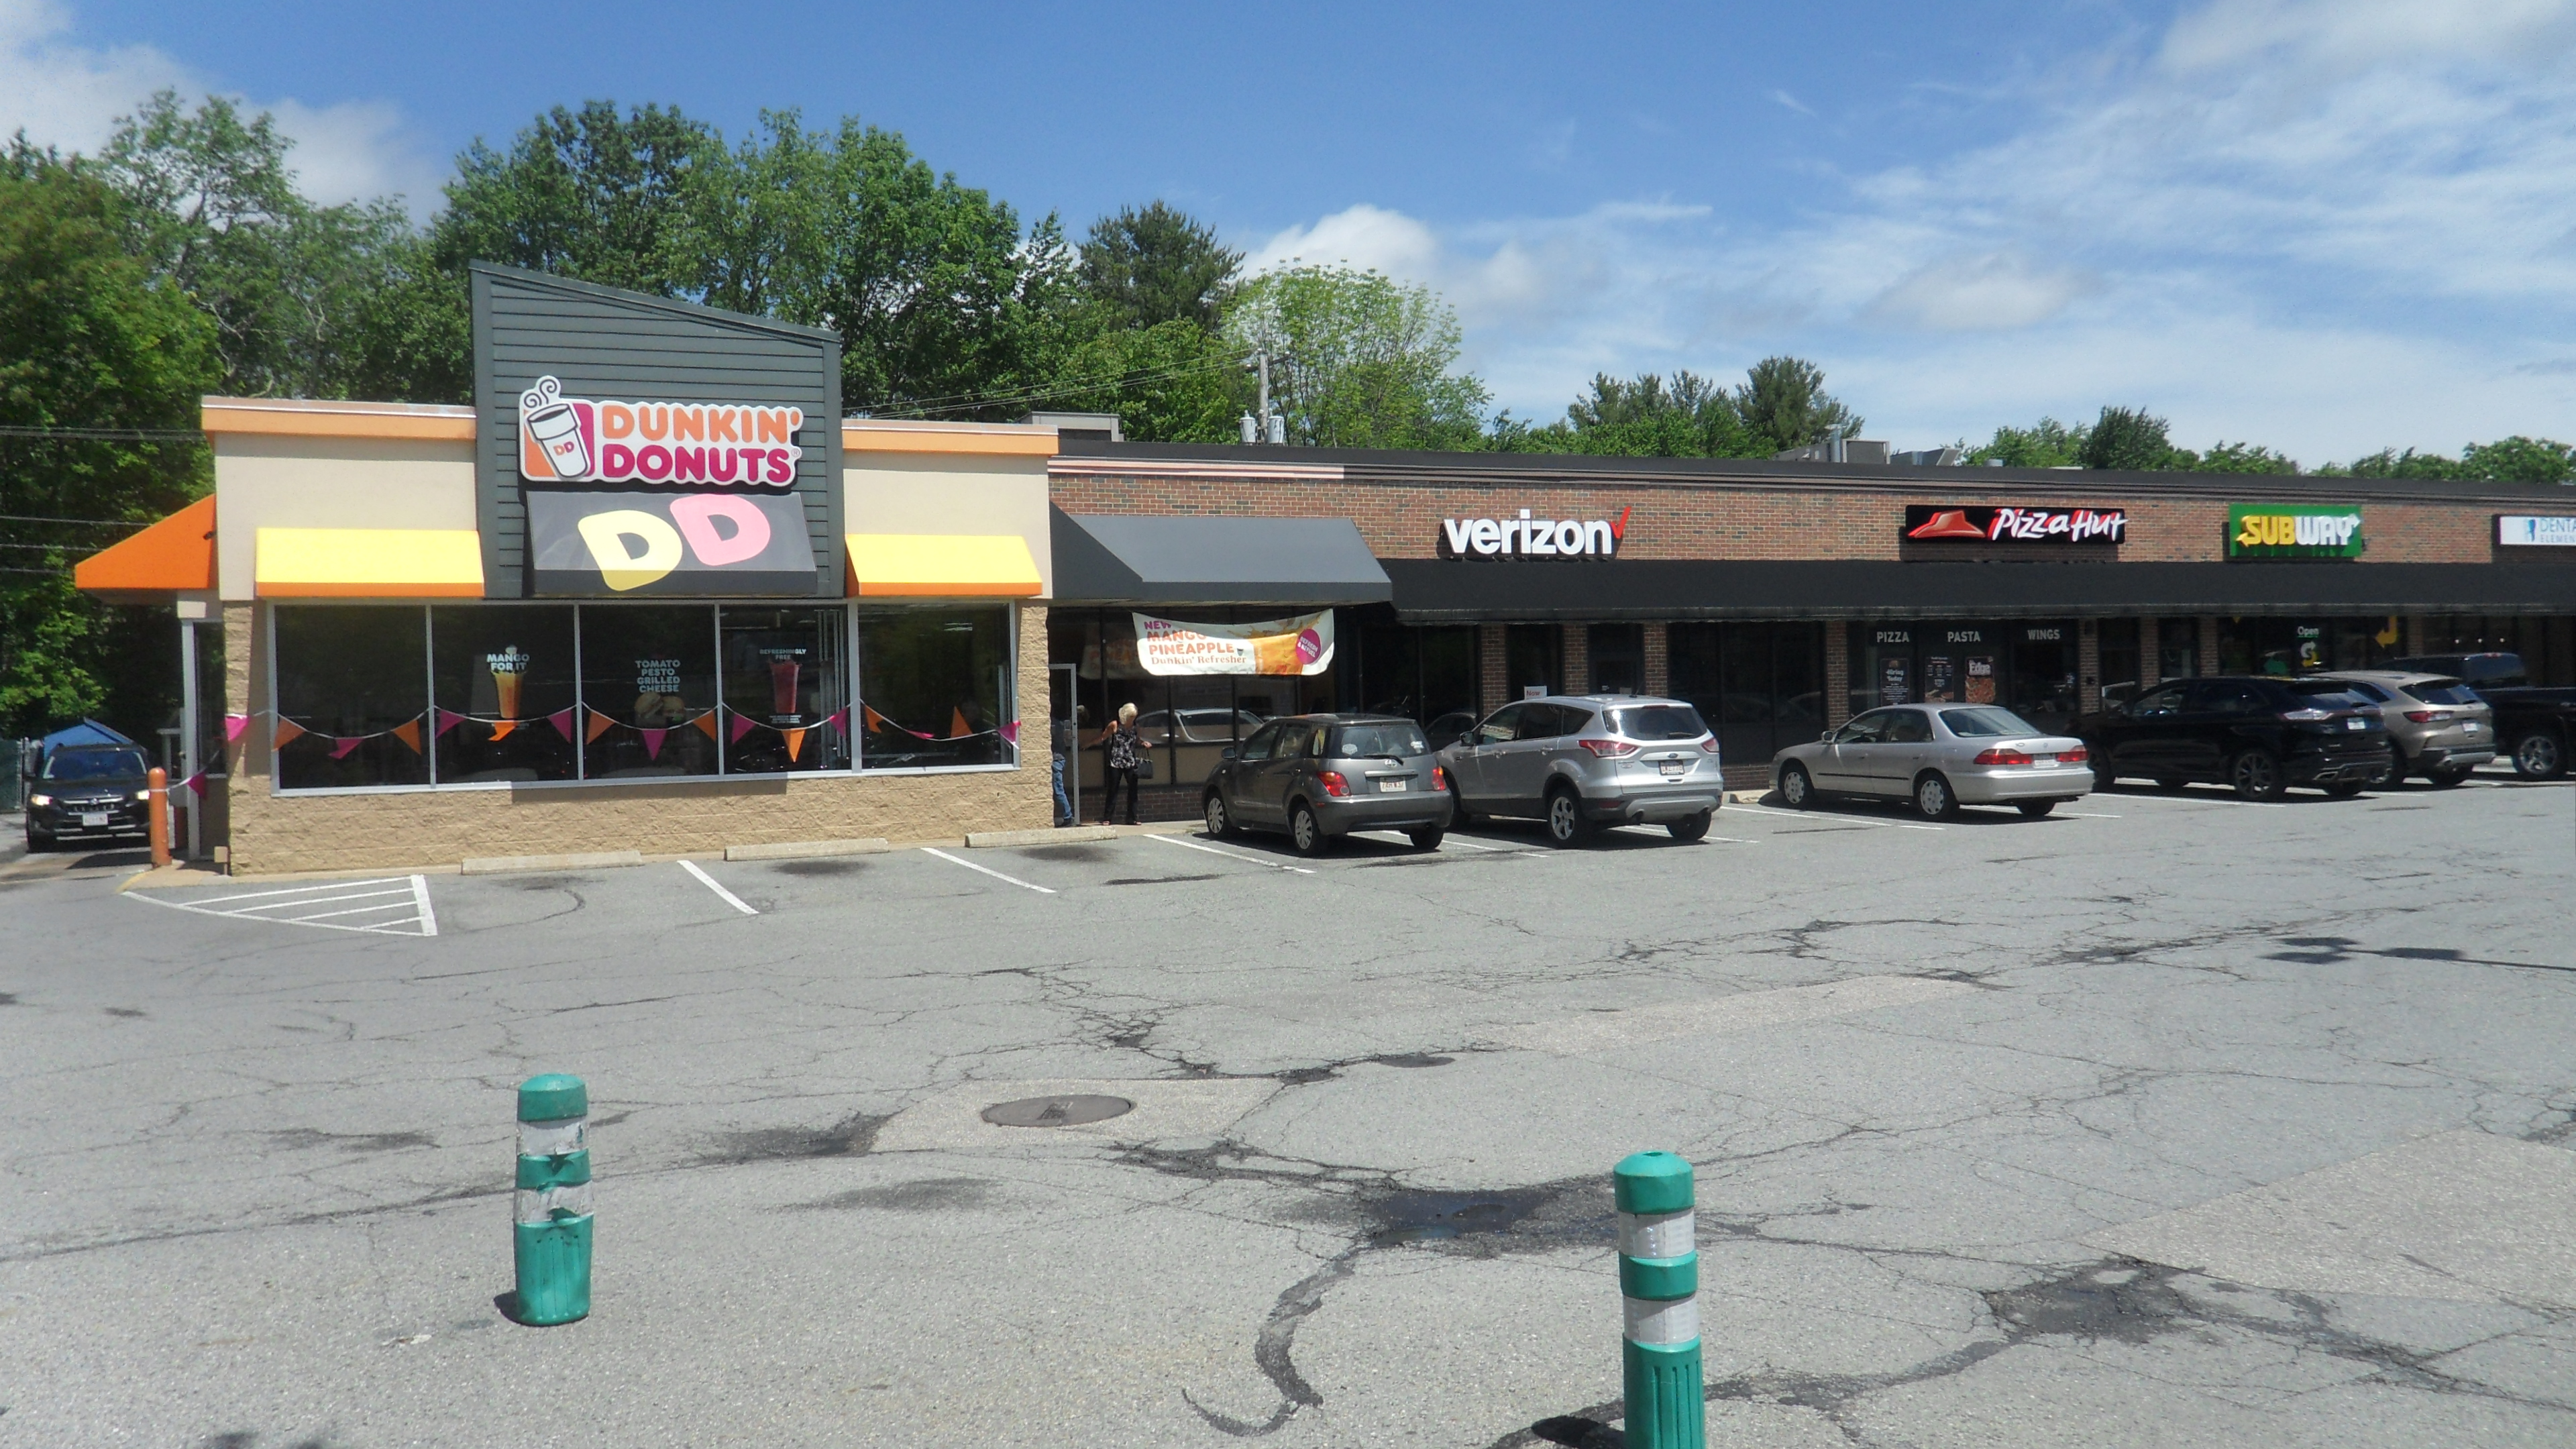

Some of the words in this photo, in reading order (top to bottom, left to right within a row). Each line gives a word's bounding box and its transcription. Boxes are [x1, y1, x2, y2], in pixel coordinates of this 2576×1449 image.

[602, 404, 800, 443] DUNKIN'
[553, 441, 575, 456] DD
[602, 443, 792, 484] DONUTS
[1988, 508, 2070, 541] Pizza
[2070, 509, 2129, 542] Hut
[2236, 513, 2361, 547] SUBWAY
[1444, 508, 1612, 555] verizon
[578, 493, 771, 591] DD
[1144, 621, 1171, 630] NEW
[1877, 631, 1909, 643] PIZZA
[1947, 631, 1981, 643] PASTA
[2027, 629, 2061, 640] WINGS
[1148, 642, 1234, 655] PINEAPPLE
[486, 653, 530, 663] MANGO
[635, 659, 681, 669] TOMATO
[1151, 656, 1194, 665] Dunkin'
[1197, 655, 1247, 663] Refresher
[490, 662, 513, 671] FOR
[515, 662, 527, 670] IT
[641, 667, 675, 676] PESTO
[637, 676, 681, 684] GRILLED
[639, 684, 680, 693] CHEESE
